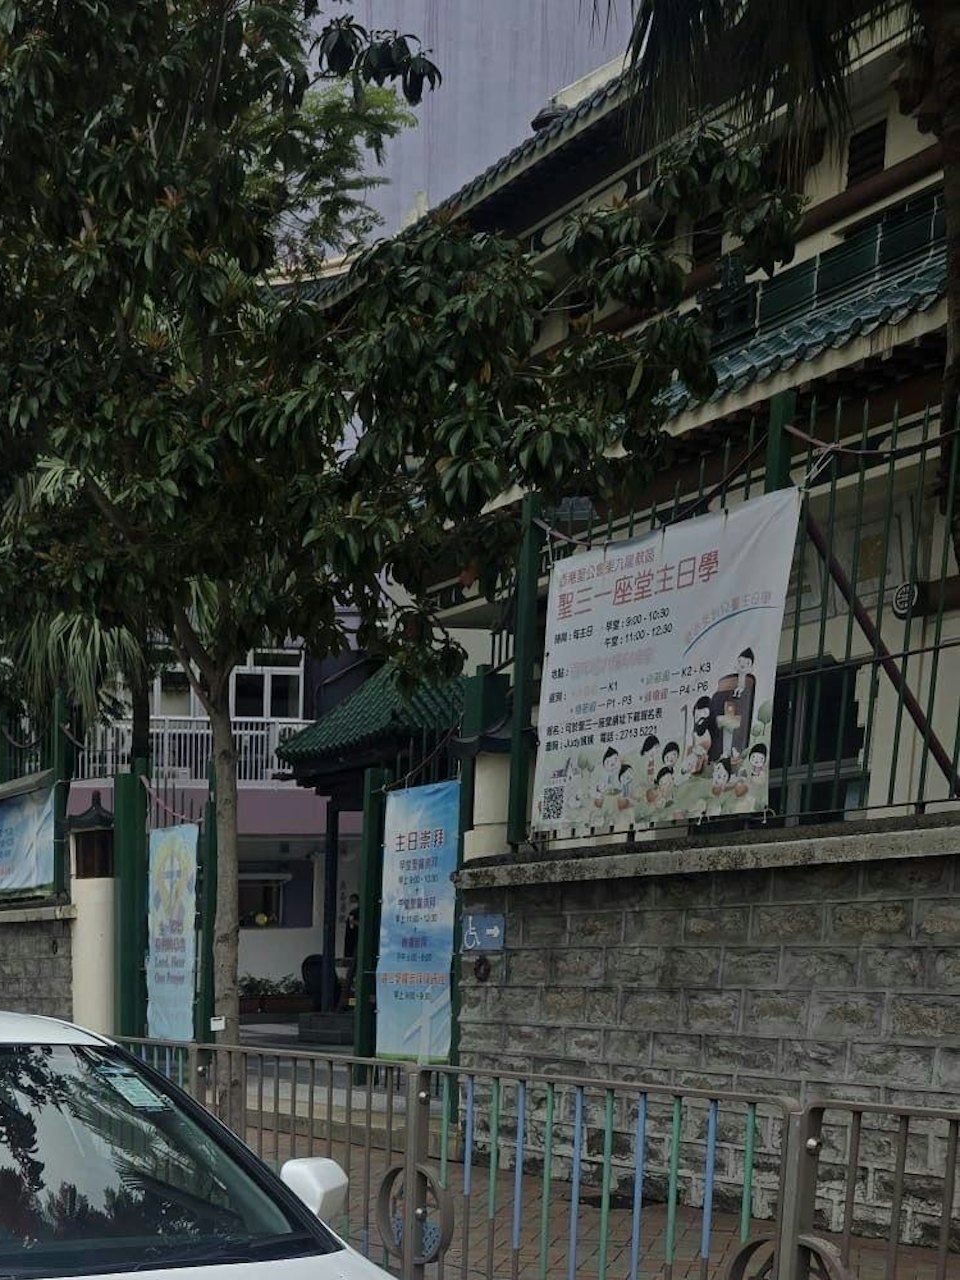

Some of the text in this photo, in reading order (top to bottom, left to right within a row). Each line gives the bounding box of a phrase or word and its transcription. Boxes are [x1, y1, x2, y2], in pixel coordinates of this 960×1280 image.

[557, 550, 719, 621] 聖三一座堂主日學
[395, 828, 444, 852] 主日崇拜
